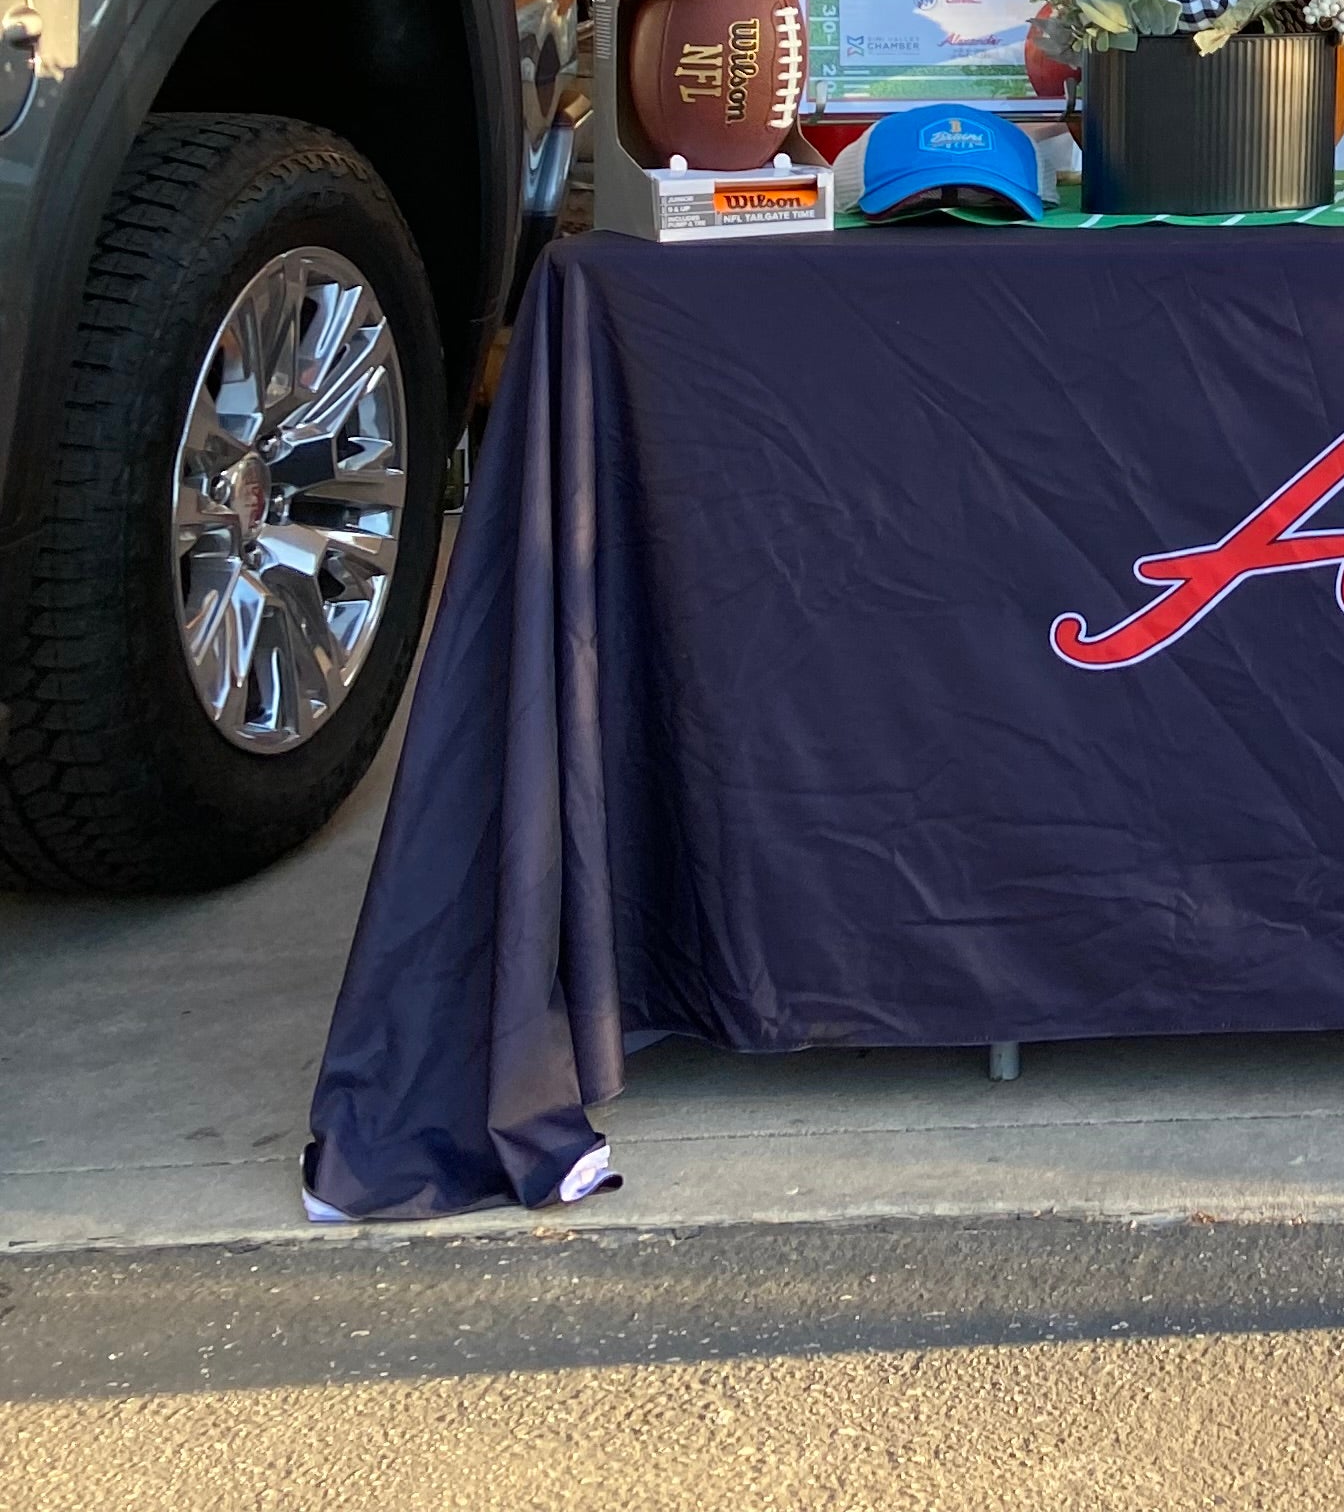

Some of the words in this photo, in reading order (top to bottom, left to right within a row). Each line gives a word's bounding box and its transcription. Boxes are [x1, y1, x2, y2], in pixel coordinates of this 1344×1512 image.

[867, 42, 920, 50] CHAMBER
[674, 43, 724, 103] NFL
[725, 18, 760, 124] Wilson
[723, 194, 801, 210] Wilson
[723, 215, 743, 224] NFL
[745, 211, 790, 223] TAILGATE
[793, 209, 815, 220] TIME
